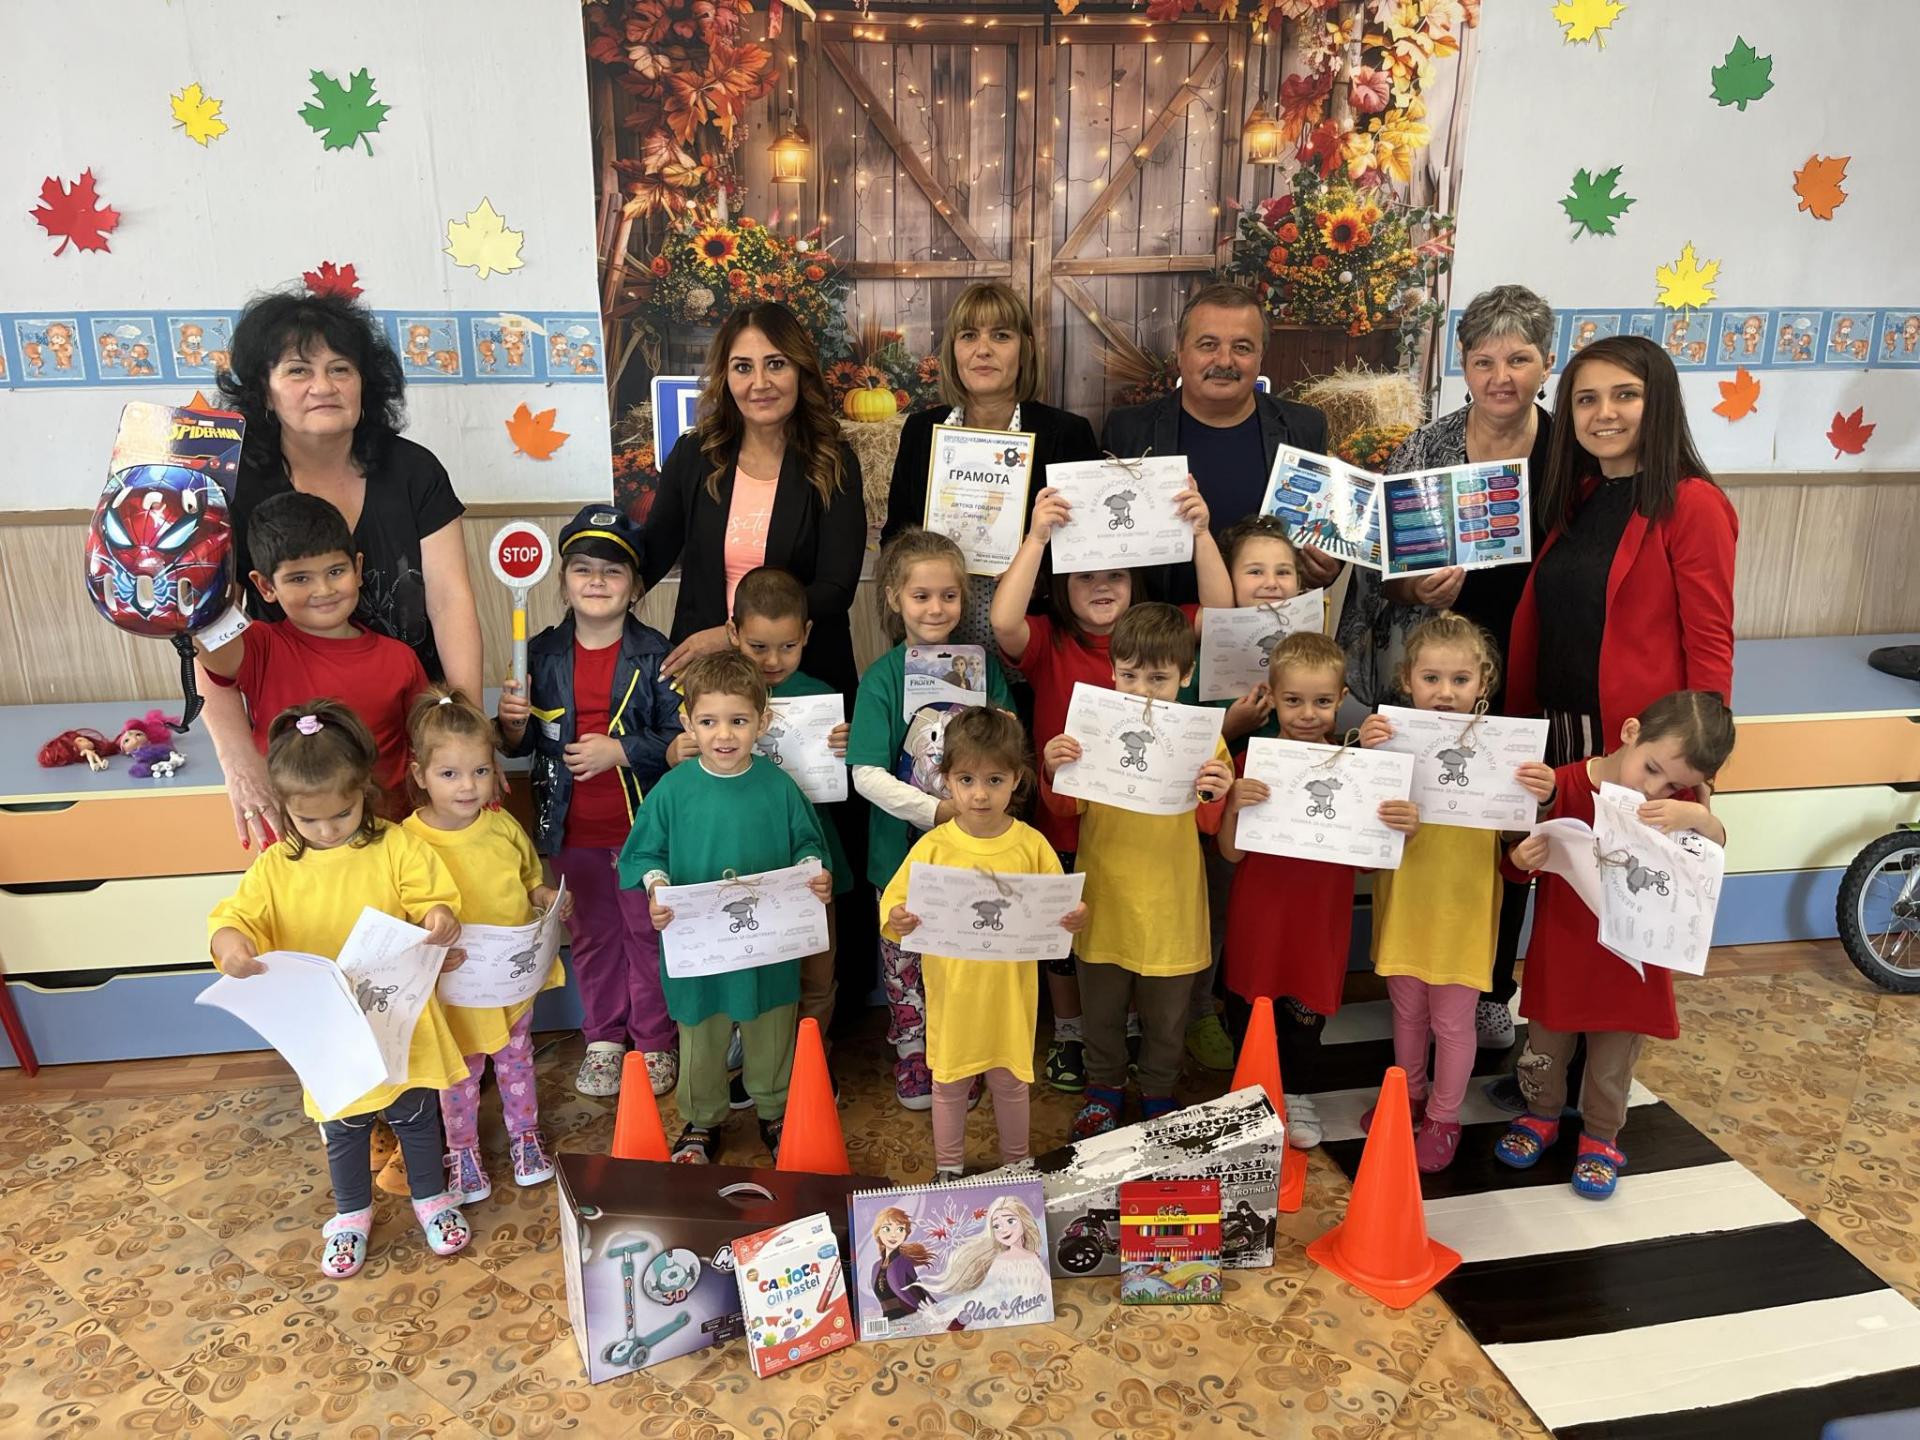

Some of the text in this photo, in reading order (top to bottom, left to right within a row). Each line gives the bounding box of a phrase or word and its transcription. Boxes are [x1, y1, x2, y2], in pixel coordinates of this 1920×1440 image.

[168, 423, 242, 441] SPIDER-MAN
[949, 469, 1010, 485] ГРАМОТА
[502, 546, 539, 563] STOP
[1260, 1144, 1276, 1154] 3+
[1204, 1159, 1263, 1174] MAXI
[1201, 1184, 1210, 1192] 24
[767, 1275, 820, 1306] Oil pastel
[957, 1293, 1047, 1325] Elsa & Anna
